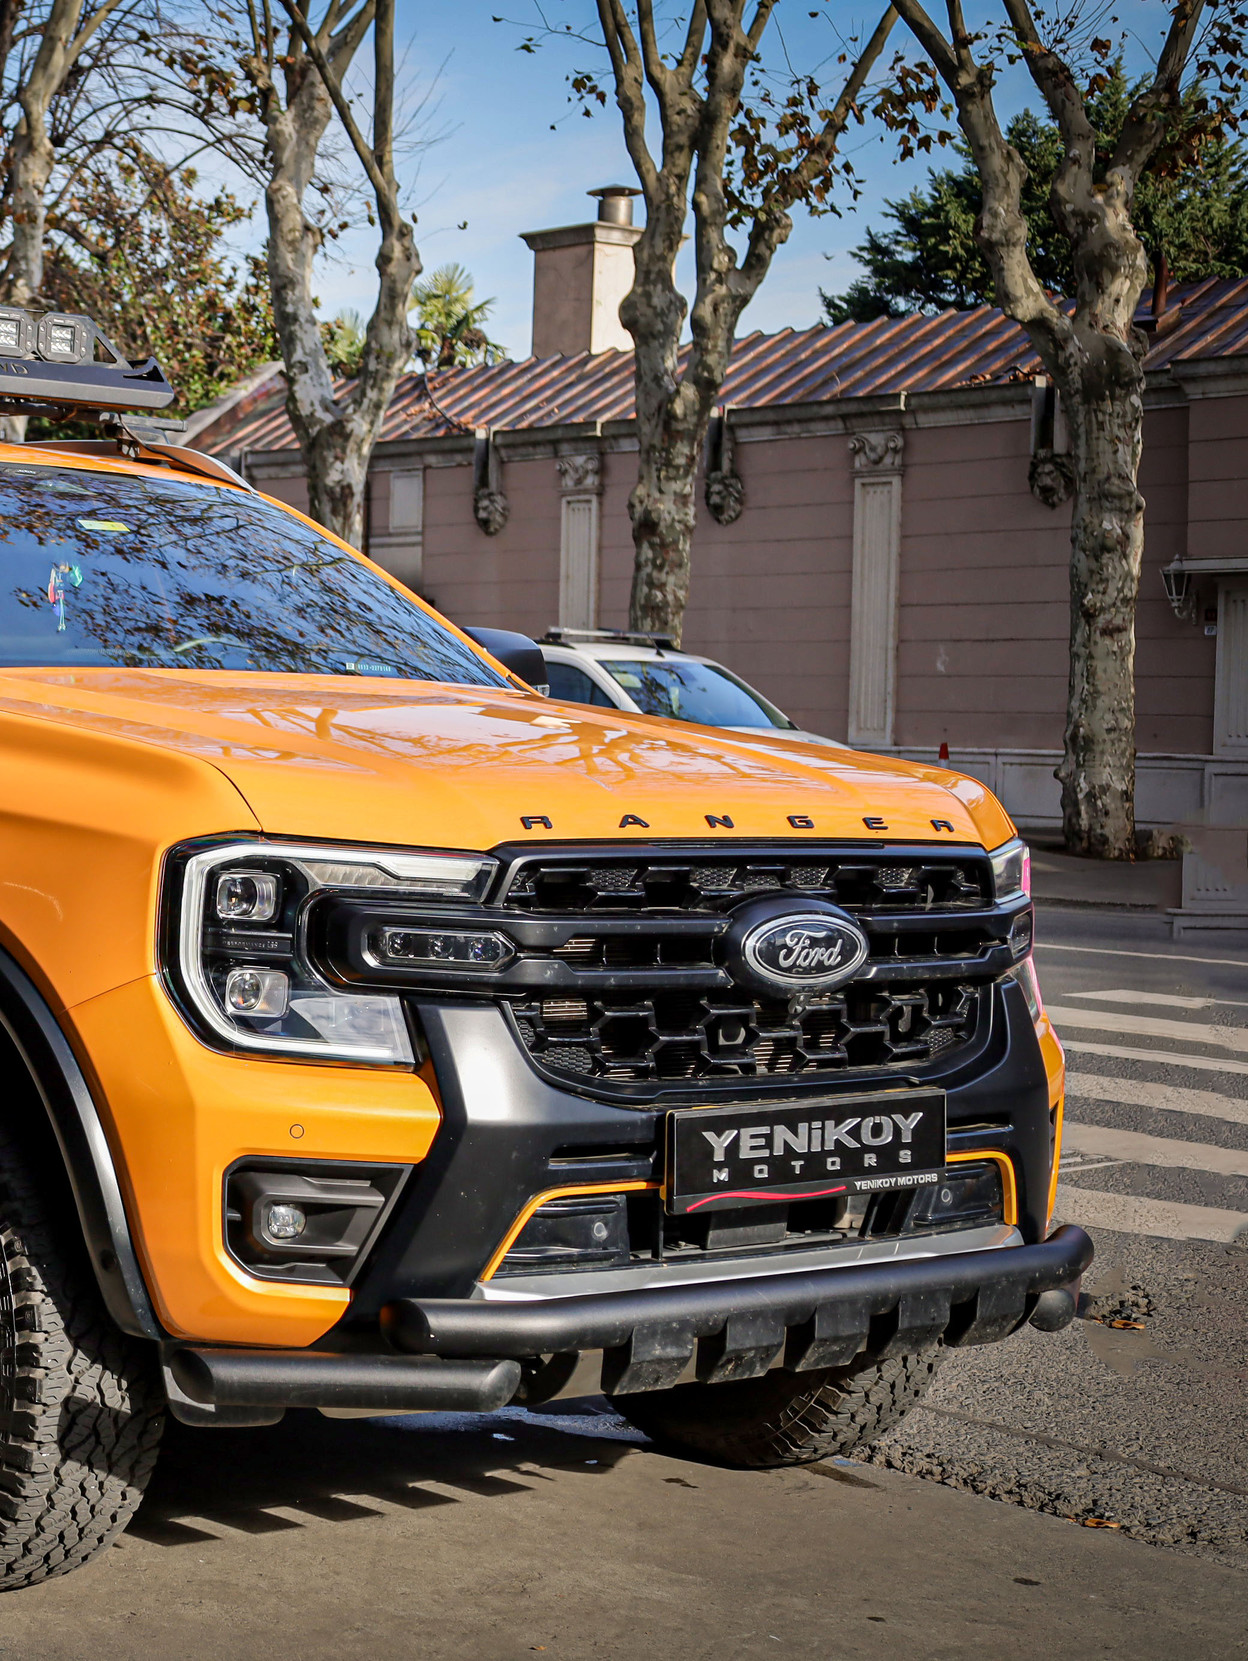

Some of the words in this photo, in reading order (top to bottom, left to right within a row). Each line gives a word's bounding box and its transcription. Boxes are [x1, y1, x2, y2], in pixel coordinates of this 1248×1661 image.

[519, 814, 955, 832] RANGER
[778, 929, 844, 968] Ford
[712, 1149, 912, 1183] MOTORS
[897, 1173, 939, 1187] MOTORS
